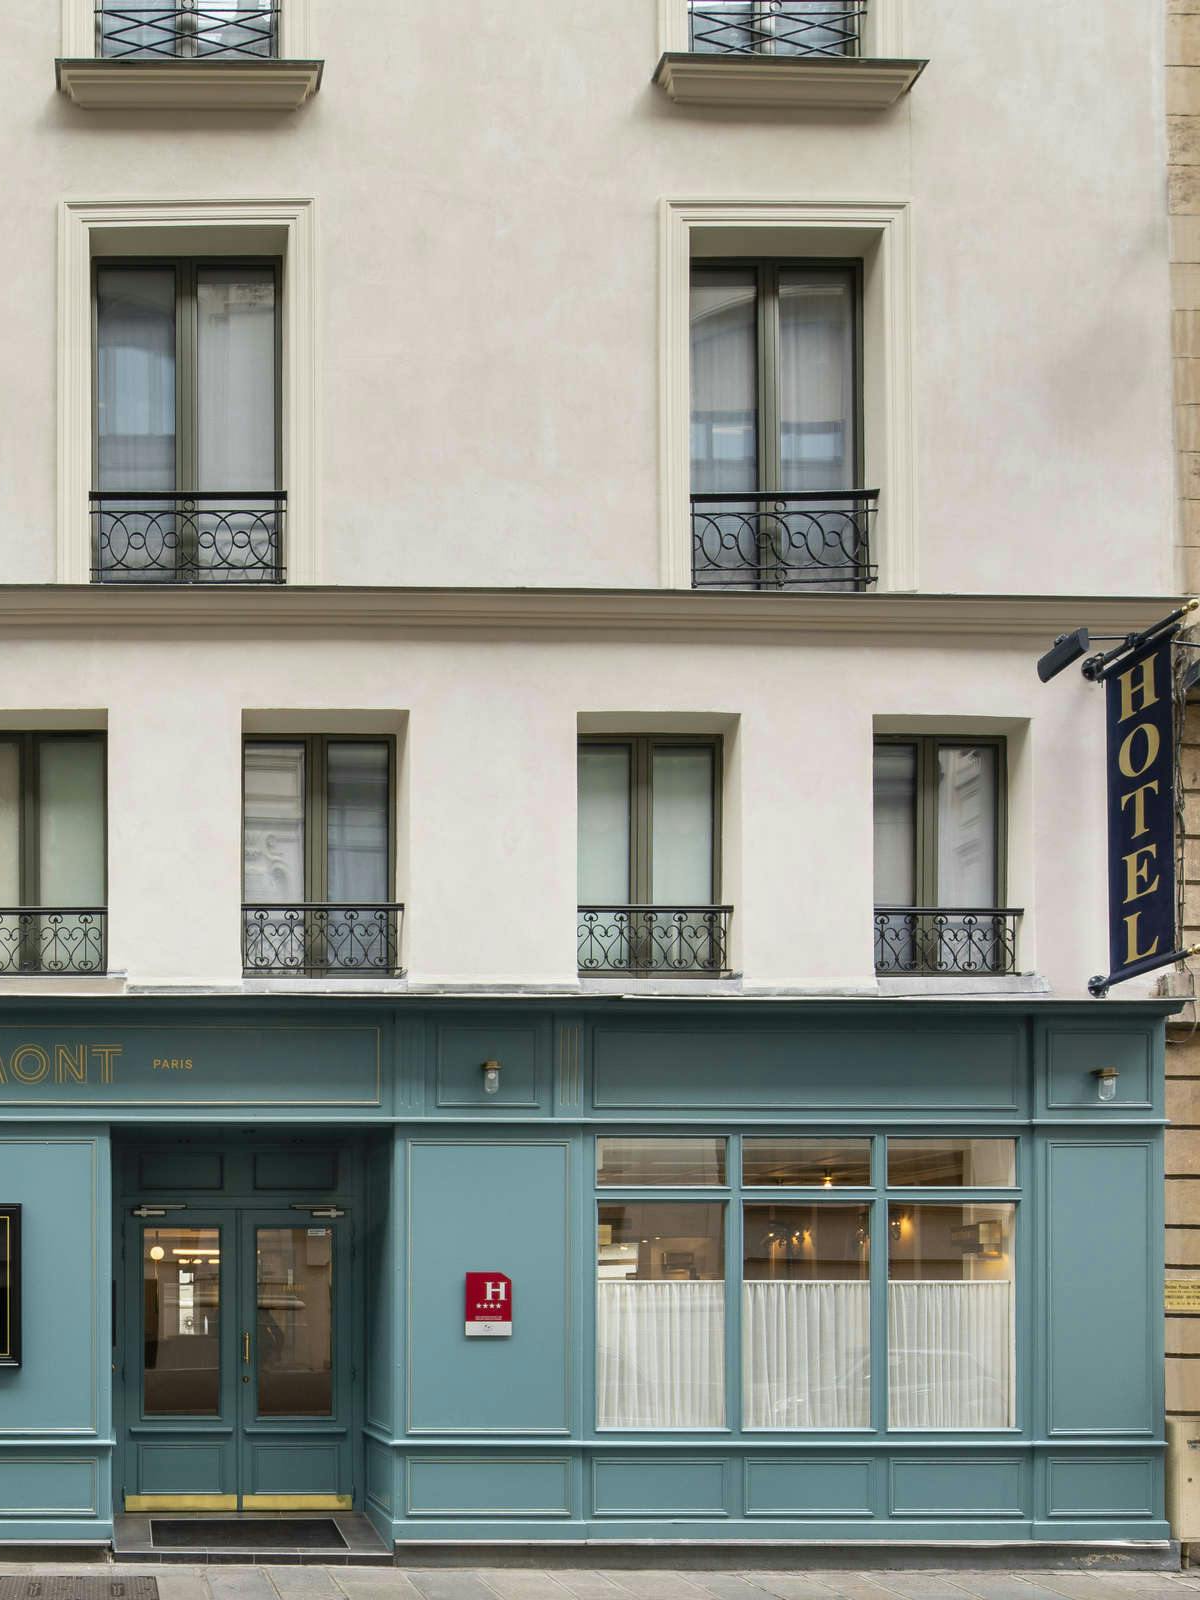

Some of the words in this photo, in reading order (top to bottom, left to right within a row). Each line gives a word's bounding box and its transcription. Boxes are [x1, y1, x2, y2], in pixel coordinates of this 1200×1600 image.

[1116, 651, 1161, 966] HOTEL
[152, 1058, 194, 1071] PARIS
[484, 1281, 508, 1301] H
